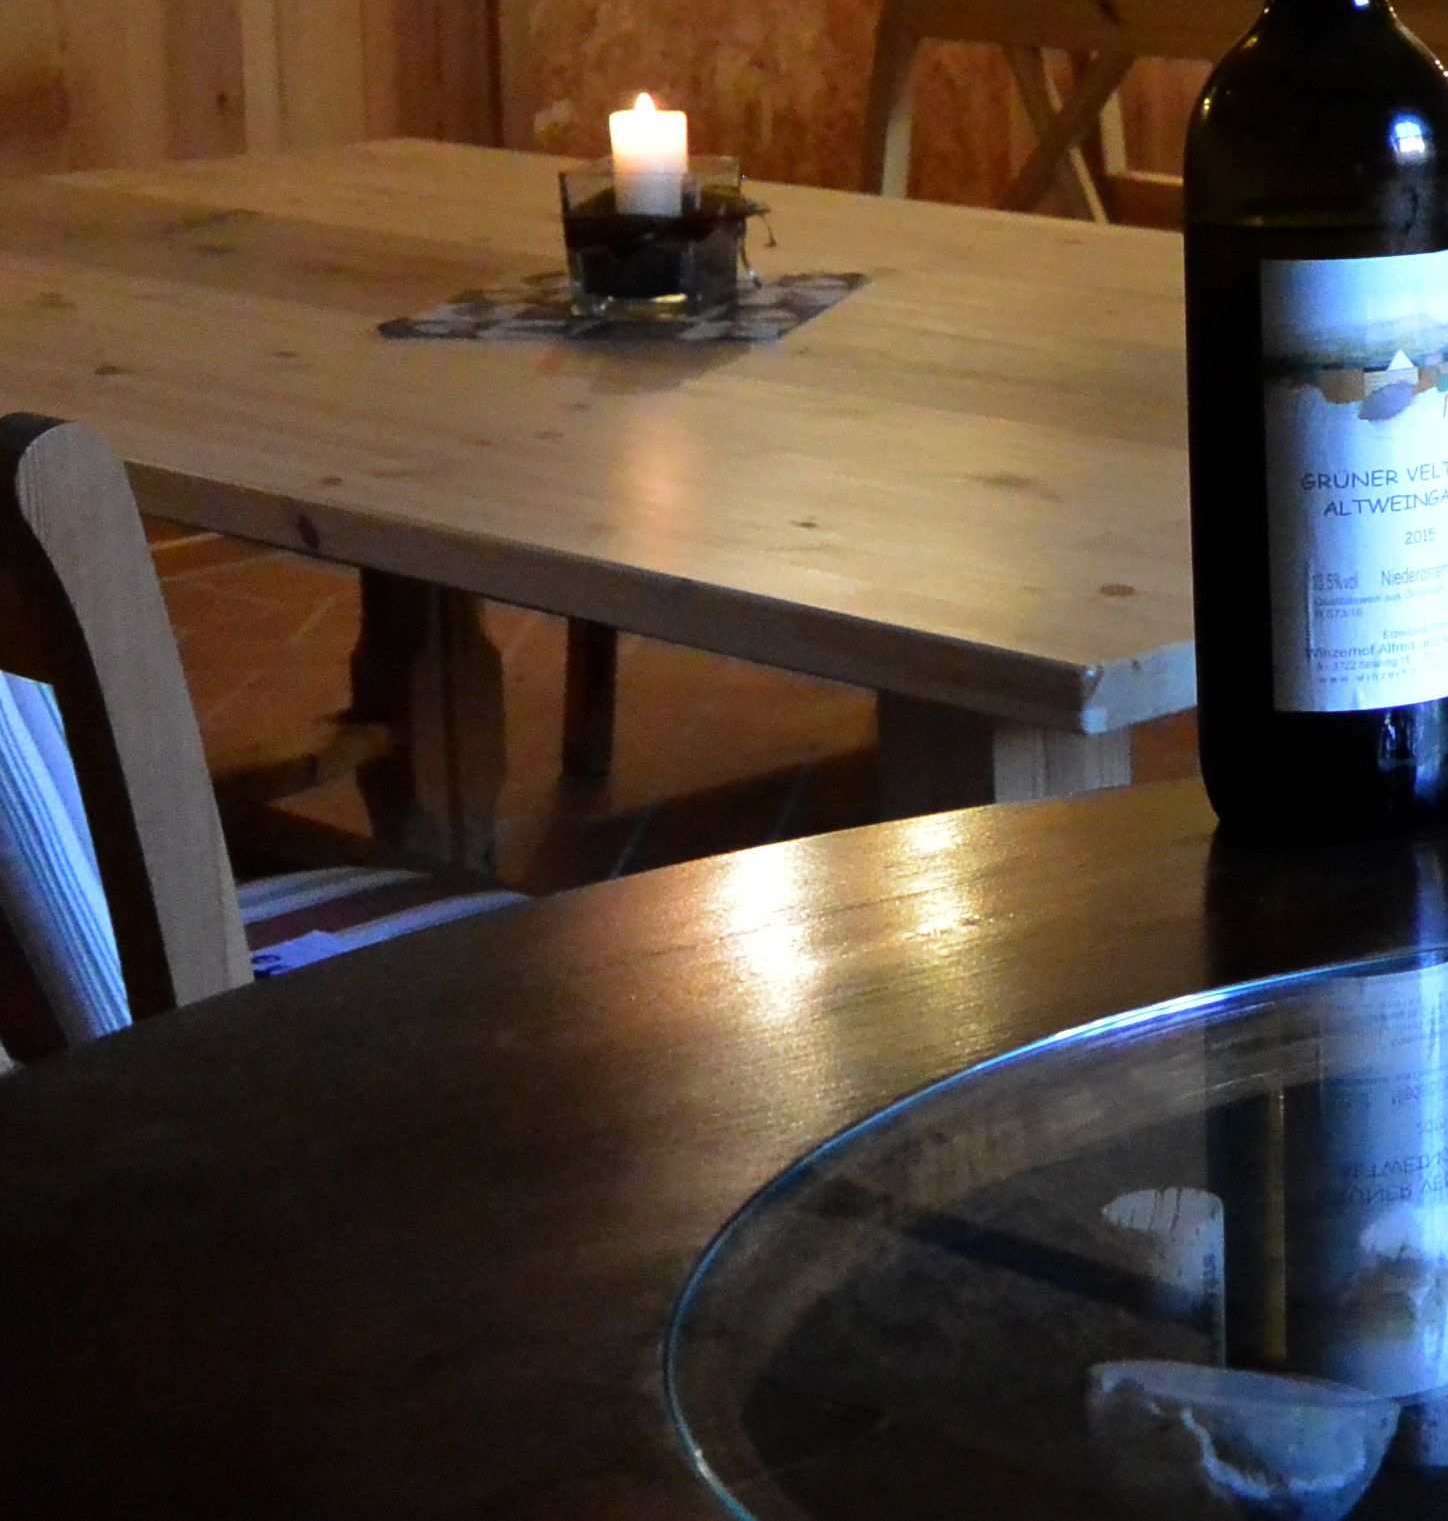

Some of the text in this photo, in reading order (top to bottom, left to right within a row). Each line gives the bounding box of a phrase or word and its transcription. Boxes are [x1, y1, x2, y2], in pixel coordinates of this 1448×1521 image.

[1301, 469, 1399, 491] GRÜNER
[1404, 527, 1437, 545] 2015
[1379, 640, 1415, 655] Alfred
